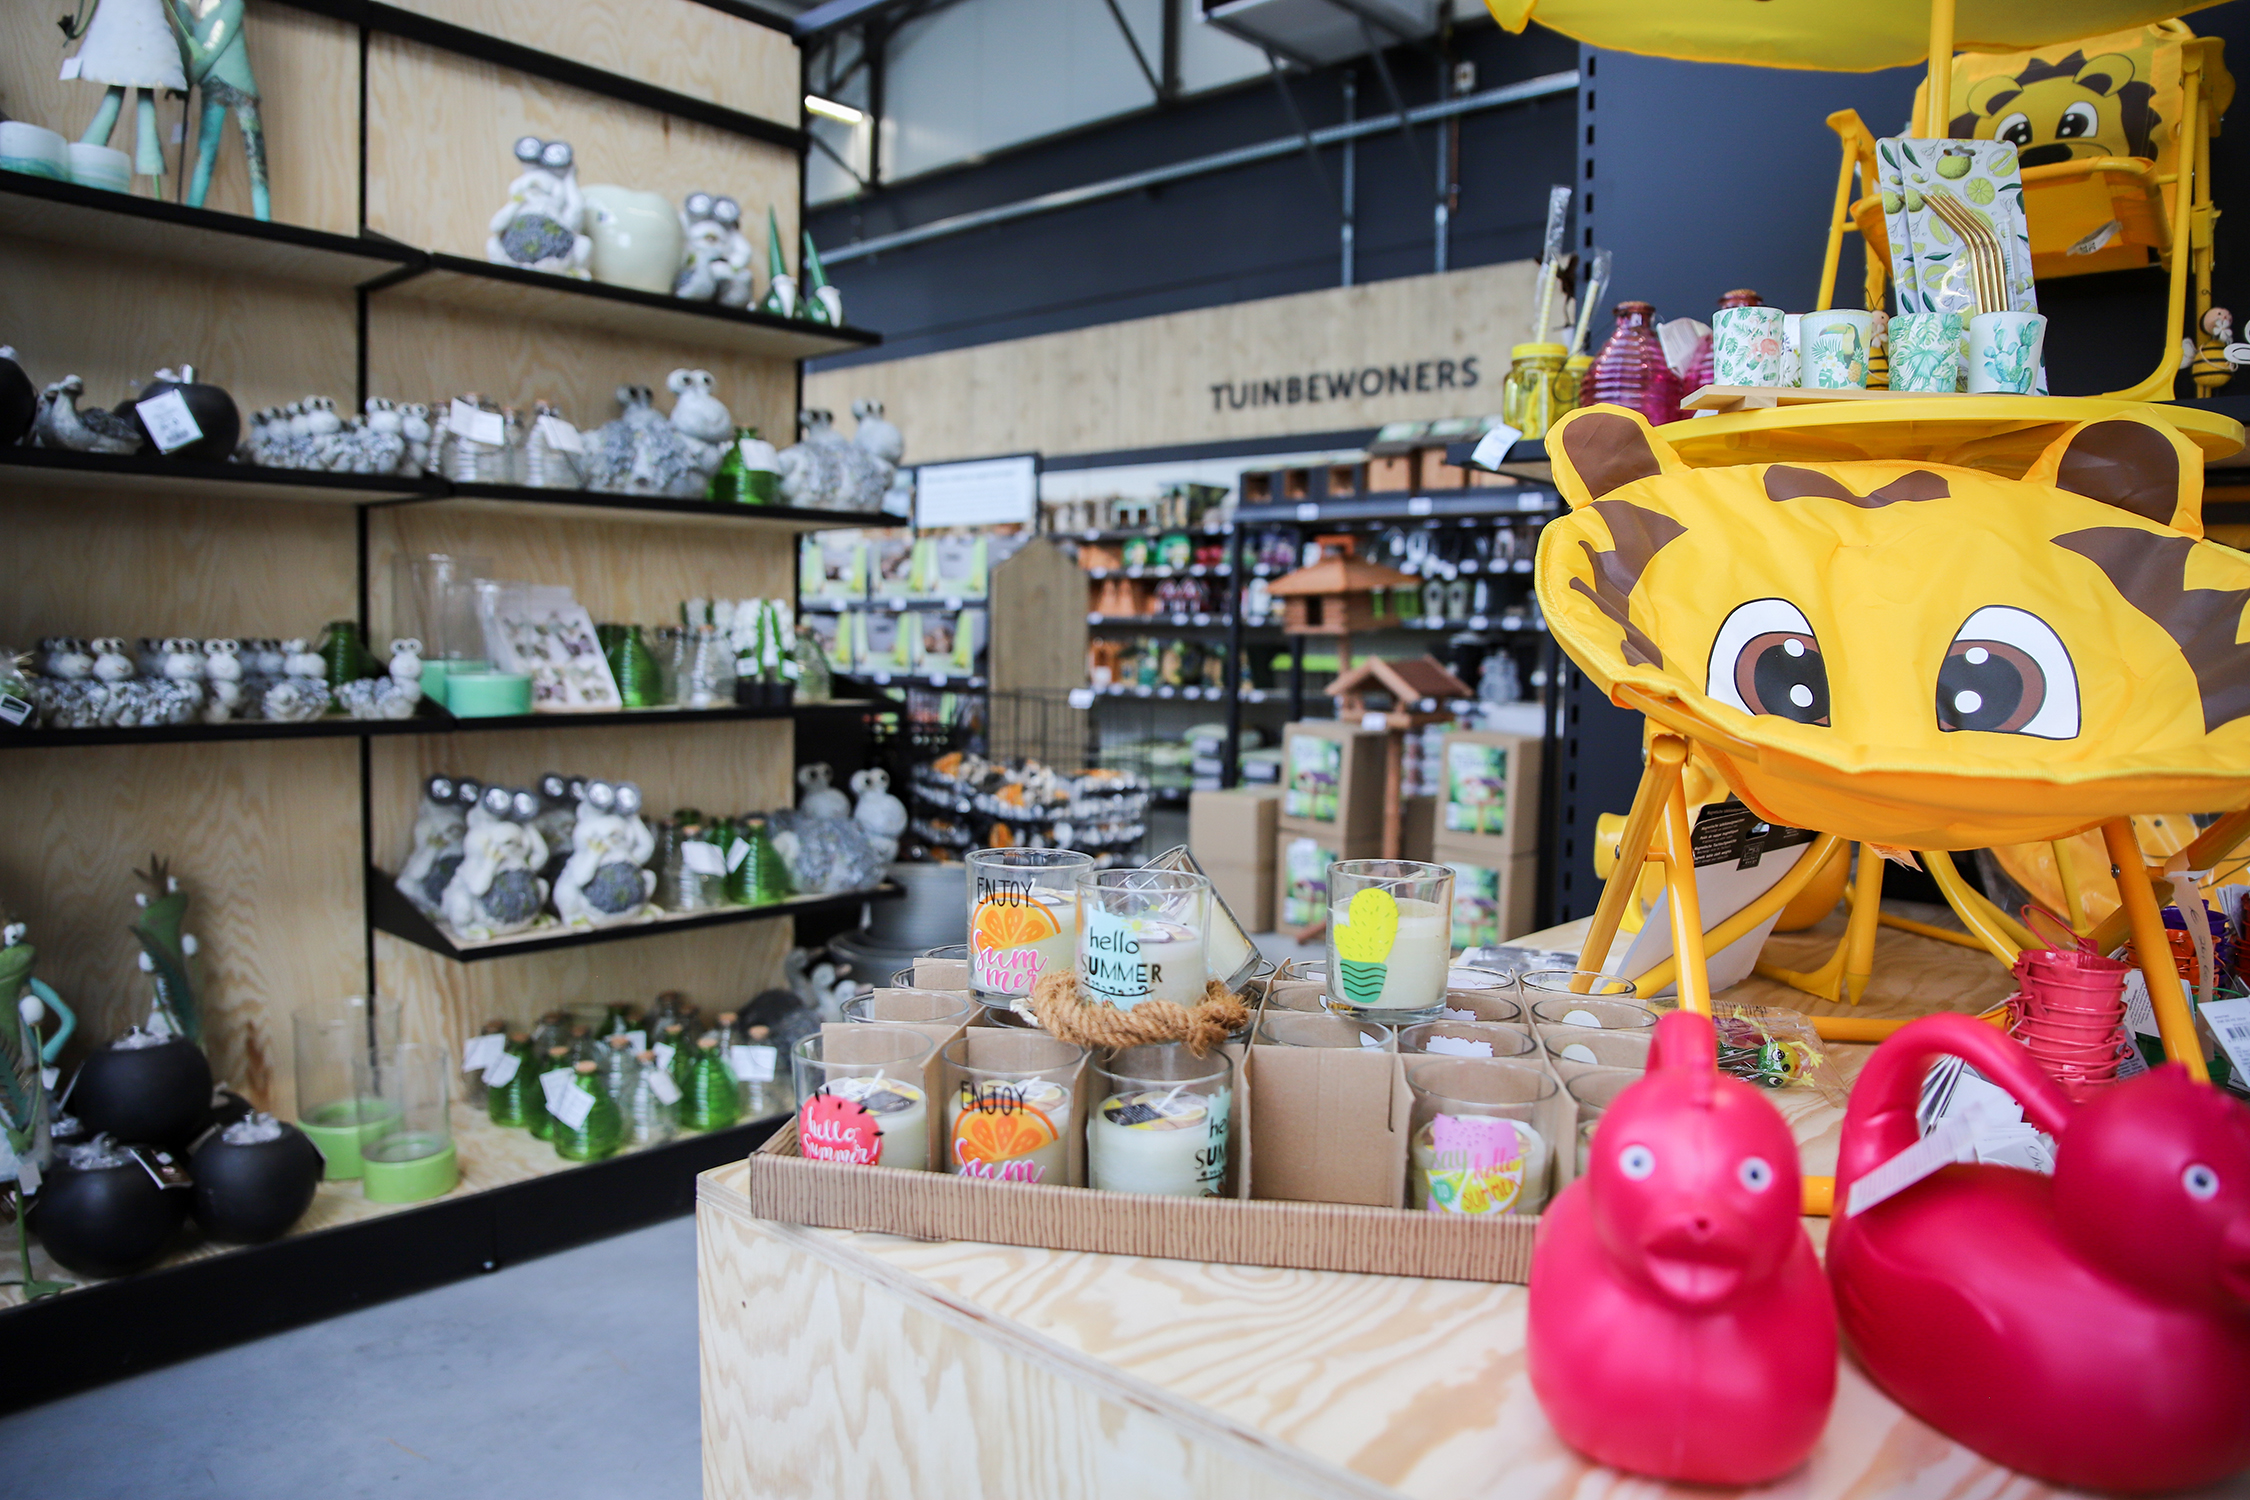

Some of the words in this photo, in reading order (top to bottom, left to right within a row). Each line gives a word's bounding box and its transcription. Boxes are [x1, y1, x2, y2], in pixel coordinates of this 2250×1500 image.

[1210, 356, 1480, 412] TUINBEWONERS
[977, 876, 1033, 908] ENJOY
[1089, 926, 1139, 954] hello
[1081, 953, 1163, 983] SUMMER
[961, 1080, 1028, 1116] ENJOY
[1462, 1175, 1522, 1210] SUMMER
